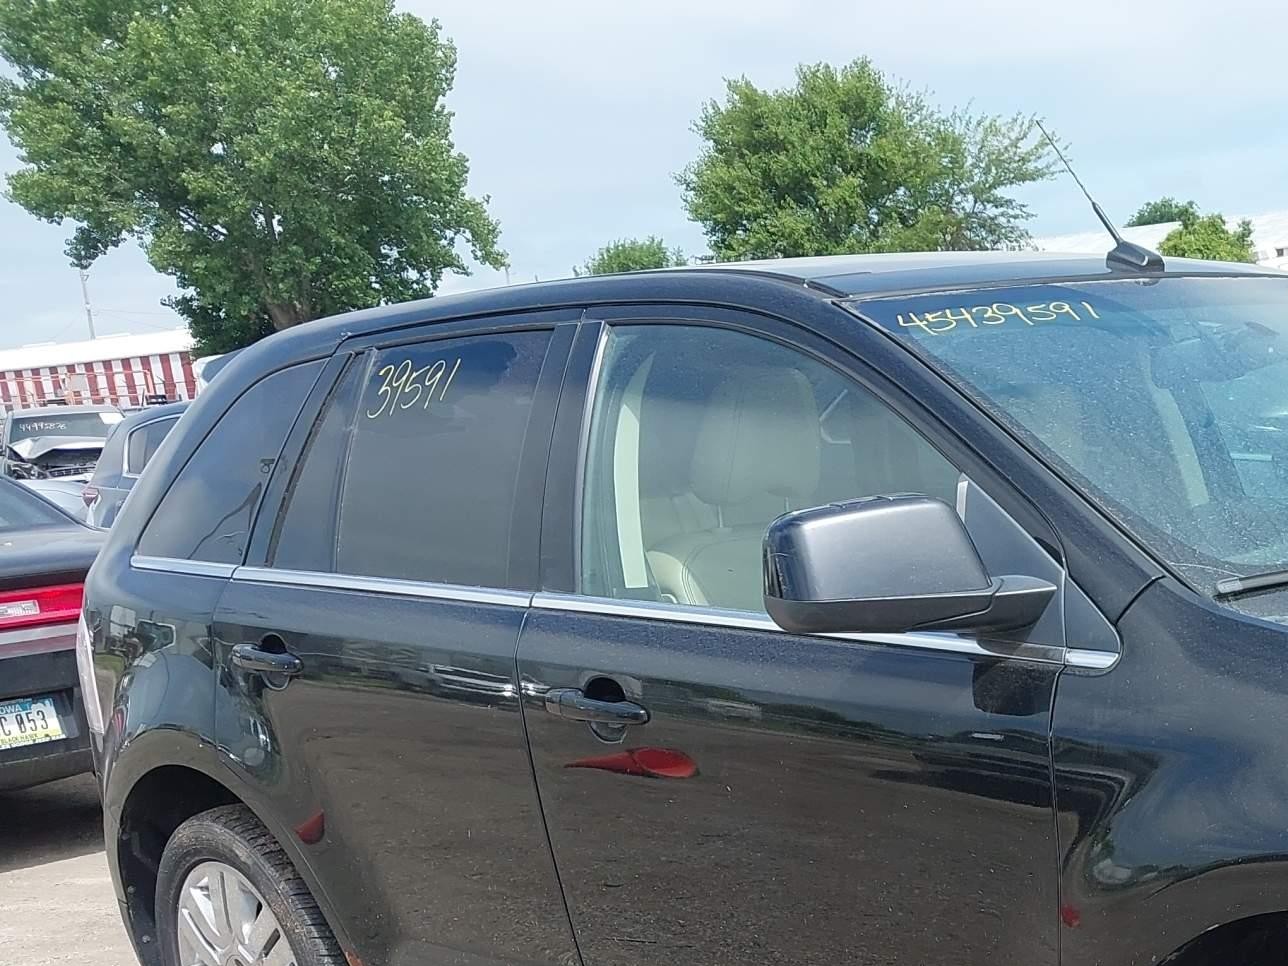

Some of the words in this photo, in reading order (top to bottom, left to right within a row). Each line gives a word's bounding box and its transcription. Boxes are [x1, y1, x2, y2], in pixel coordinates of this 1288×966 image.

[896, 301, 1100, 336] 45439591
[366, 358, 462, 419] 39591
[15, 710, 48, 733] 053
